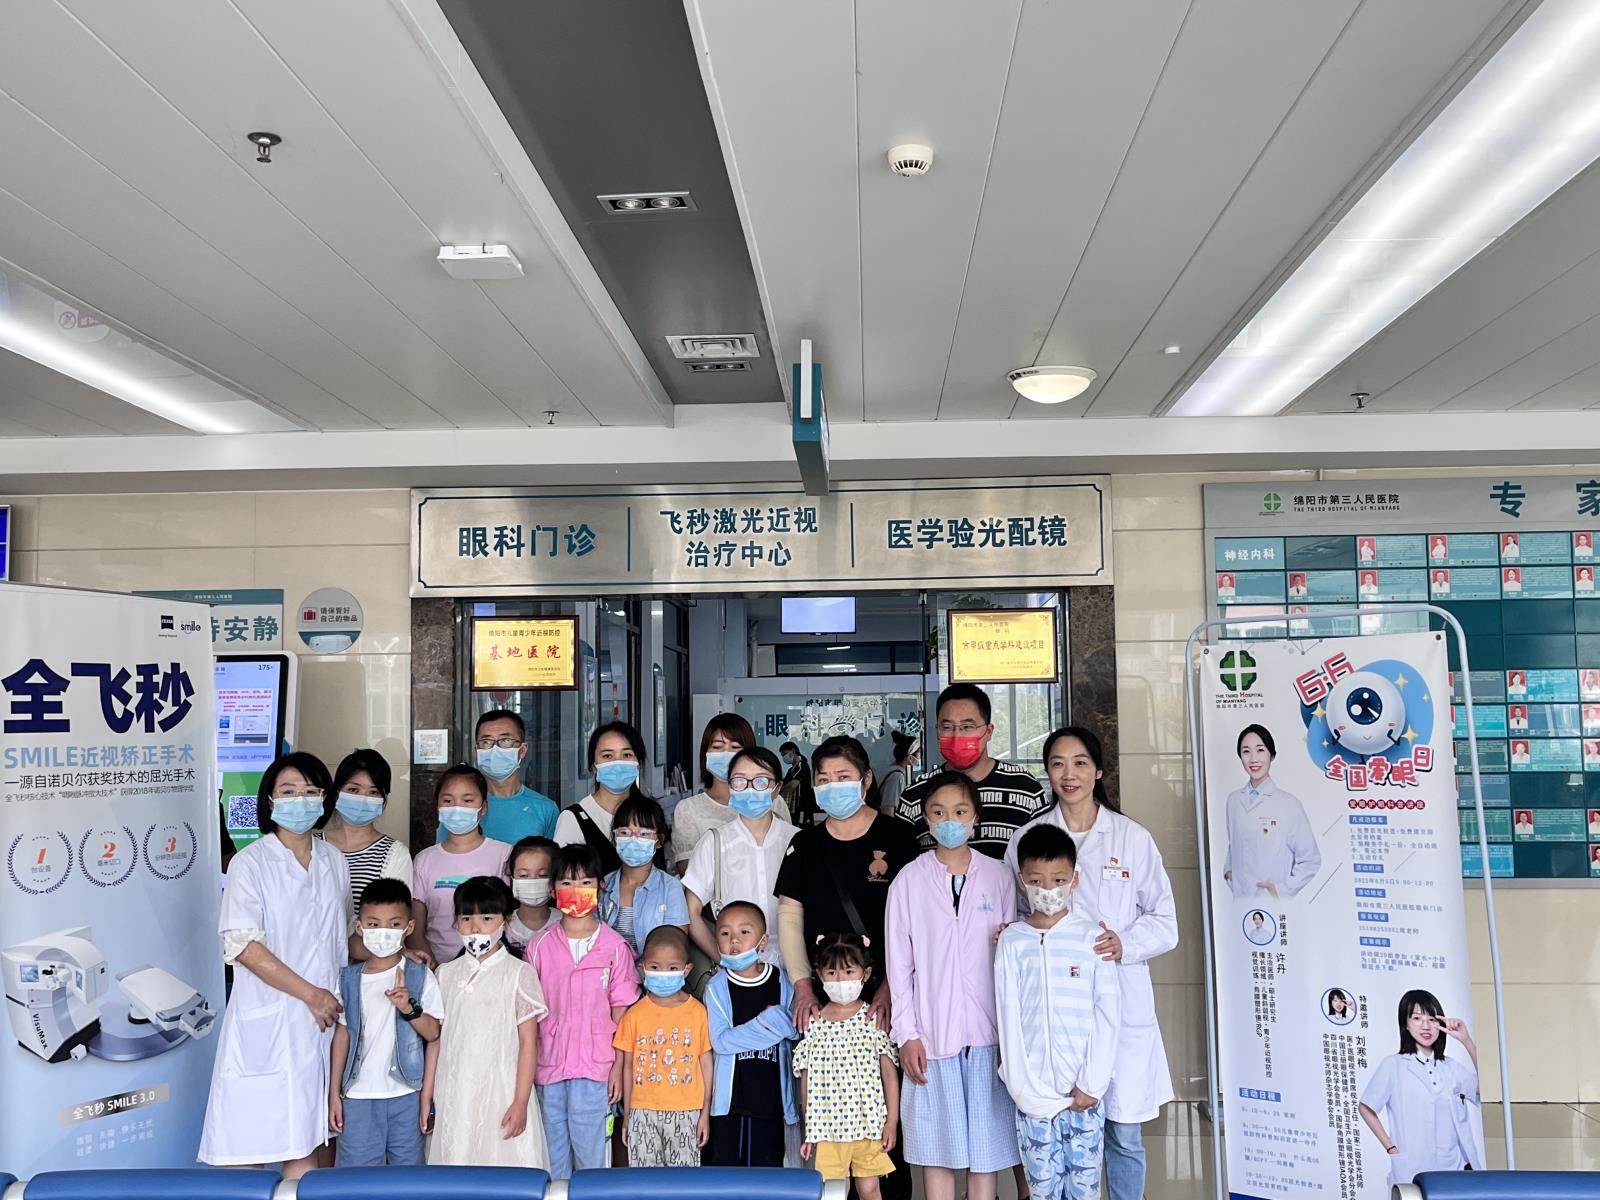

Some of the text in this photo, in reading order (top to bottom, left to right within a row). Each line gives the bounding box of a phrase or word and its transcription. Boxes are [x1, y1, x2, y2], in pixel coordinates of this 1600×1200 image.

[1293, 493, 1400, 506] 绵阳市第三人民医院
[660, 506, 818, 535] 飞秒激光近视
[887, 515, 1067, 549] 医学验光配镜
[458, 523, 597, 559] 眼科门诊
[686, 540, 791, 568] 治疗中心
[1224, 548, 1275, 562] 神经内科
[489, 644, 561, 660] 基地医院
[1, 658, 195, 734] 全飞秒
[4, 743, 195, 769] SMILE近视矫正手术
[1326, 746, 1432, 789] 全国爱眼日
[1008, 792, 1043, 812] PUMA
[37, 848, 47, 864] 1
[102, 842, 116, 858] 2
[165, 836, 177, 853] 3
[1279, 914, 1288, 946] 讲座讲师
[1276, 952, 1287, 974] 许丹
[1359, 995, 1368, 1029] 特邀讲师
[33, 1013, 48, 1050] VisuMax
[1356, 1036, 1368, 1069] 刘寒梅
[73, 1090, 155, 1120] 全飞秒 SMILE 3.0
[1241, 1088, 1276, 1101] 活动日程
